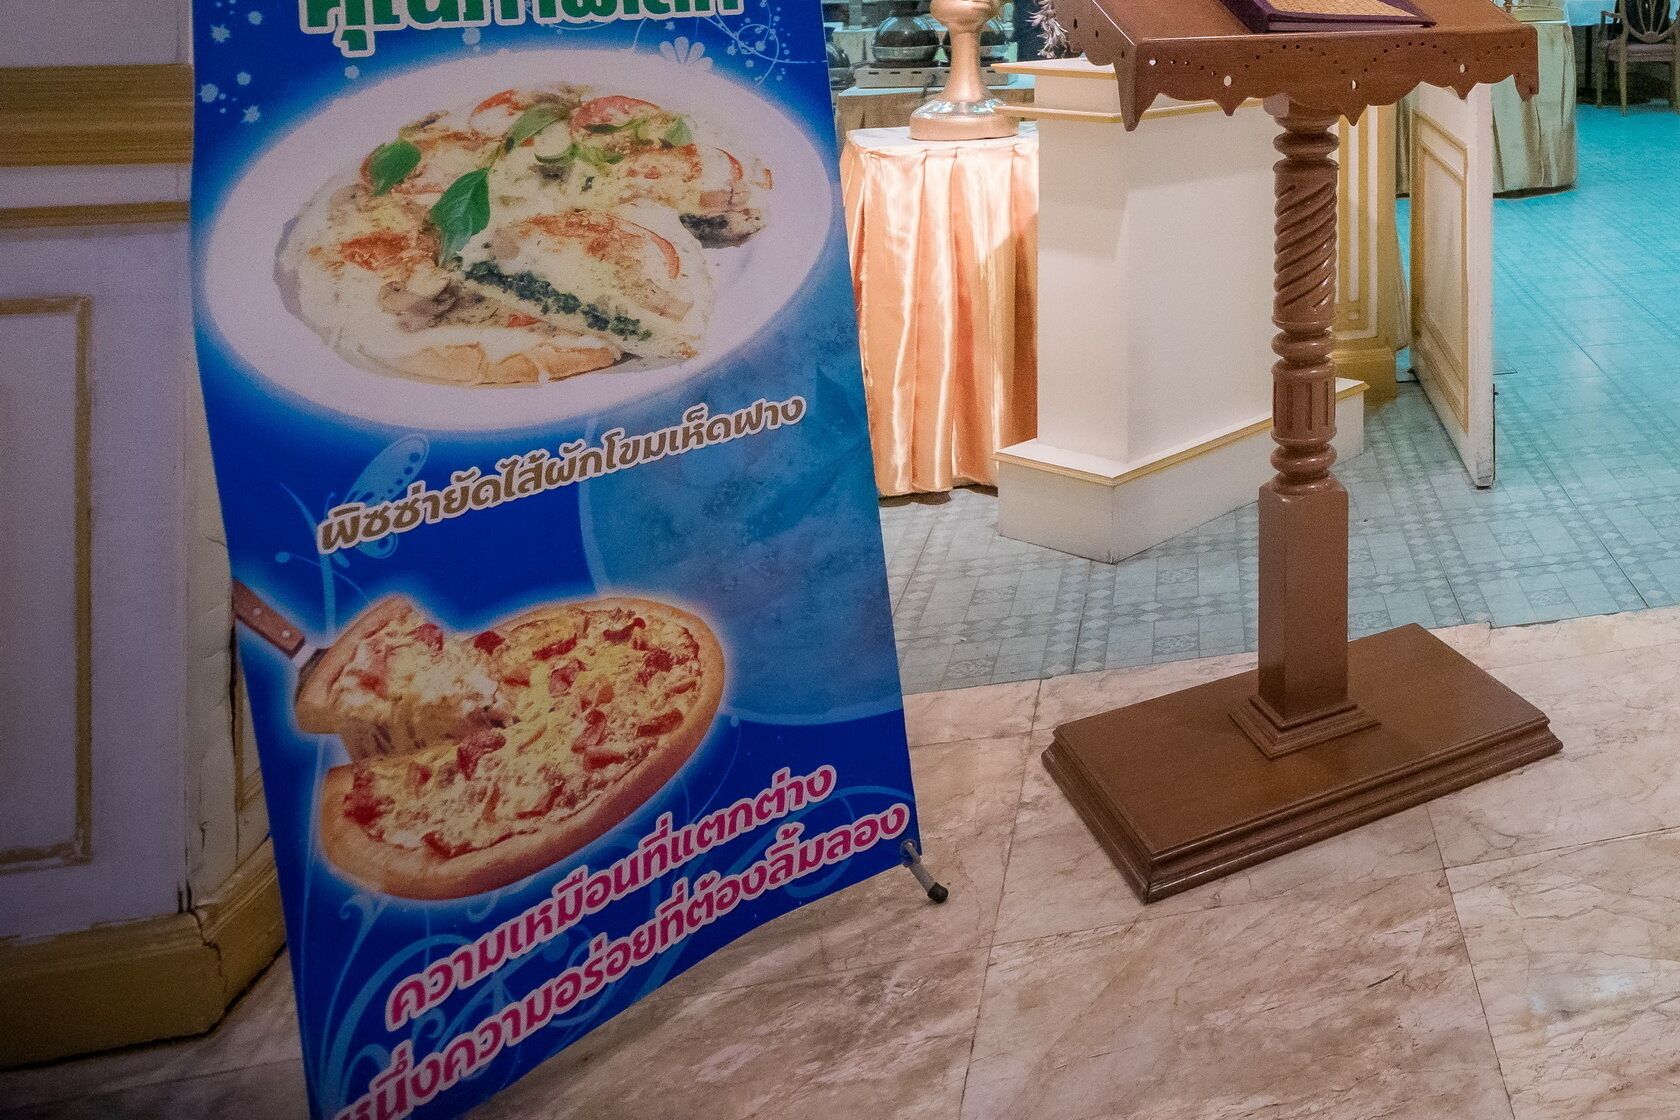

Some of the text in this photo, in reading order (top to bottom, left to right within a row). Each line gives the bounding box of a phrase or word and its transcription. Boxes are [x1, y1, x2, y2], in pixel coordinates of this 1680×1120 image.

[319, 396, 805, 552] พิซซ่ายัดไส้ผักโขมเห็ดฟาง
[388, 766, 835, 1029] ความเหมือนที่แตกต่าง
